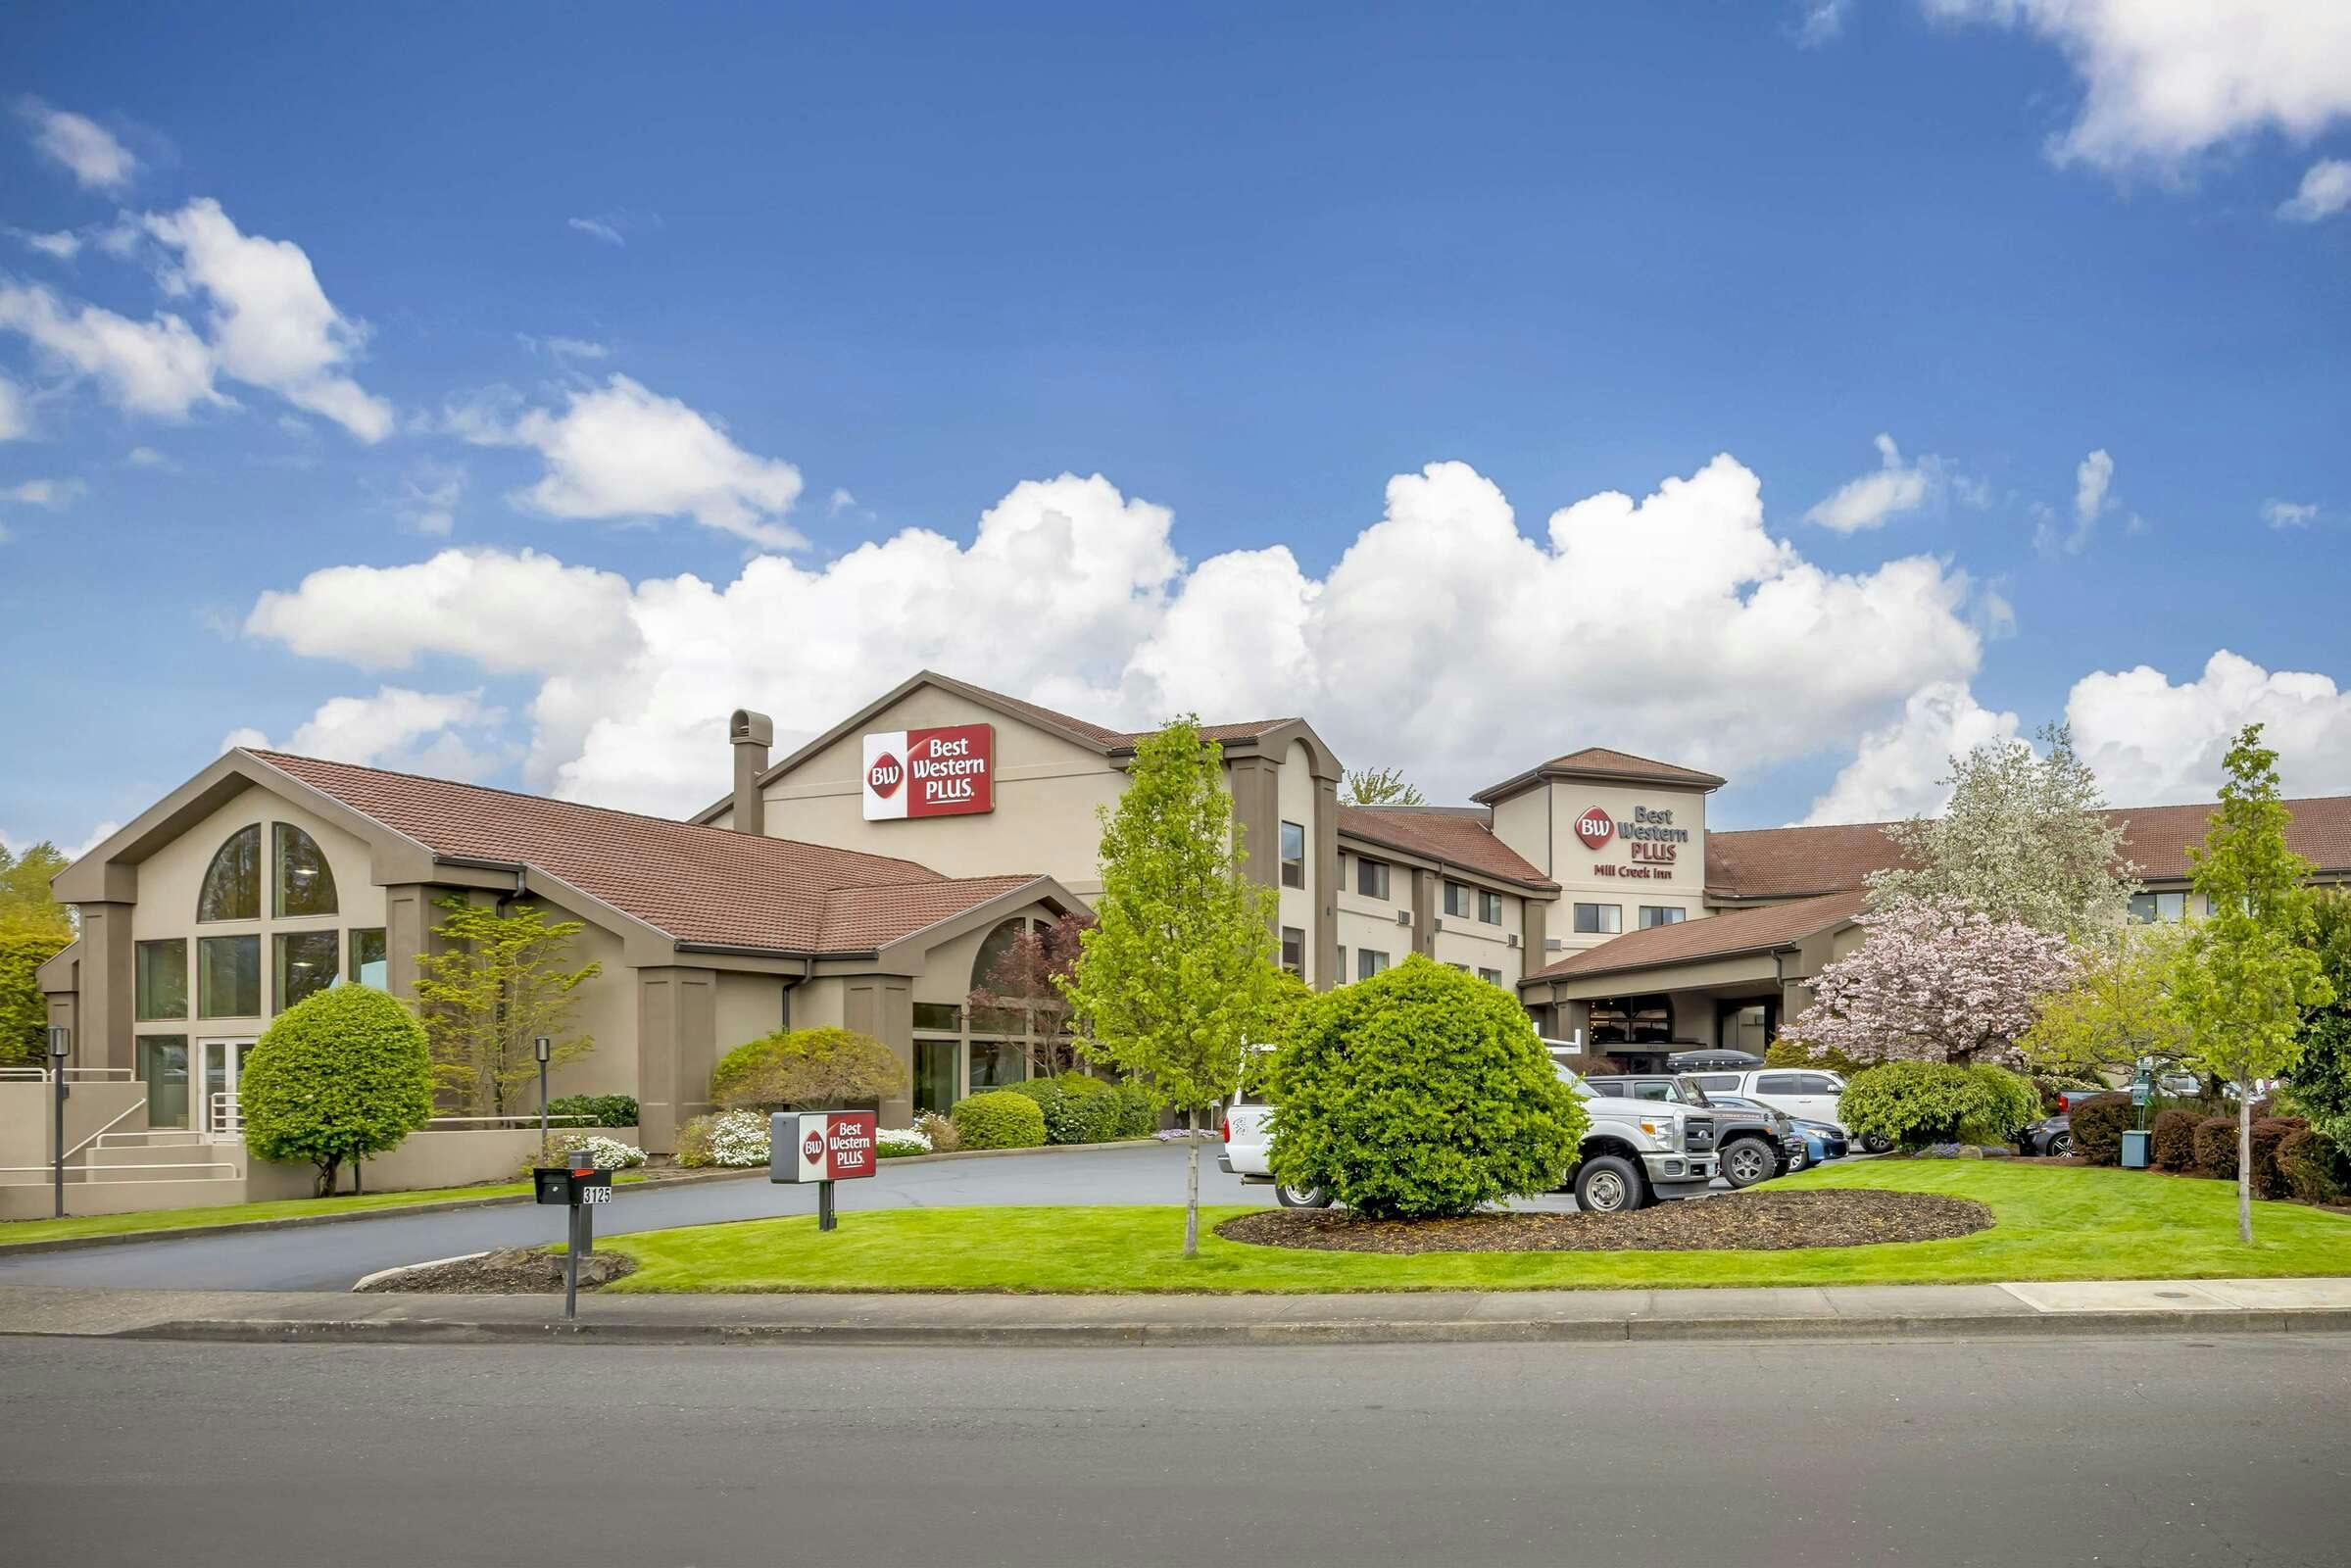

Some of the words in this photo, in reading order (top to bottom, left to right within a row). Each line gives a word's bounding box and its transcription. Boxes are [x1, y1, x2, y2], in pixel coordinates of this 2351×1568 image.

[930, 738, 968, 758] Best
[871, 766, 900, 785] BW
[912, 759, 985, 778] Western
[1635, 806, 1674, 824] Best
[1581, 819, 1610, 836] BW
[1617, 822, 1689, 843] Western
[1631, 842, 1677, 860] PLUS
[1593, 864, 1616, 877] Mill
[1618, 865, 1650, 878] Creek
[1653, 868, 1672, 880] Inn
[839, 1122, 862, 1136] Best
[806, 1141, 822, 1154] BW
[829, 1137, 870, 1151] Western
[585, 1188, 611, 1202] 3125
